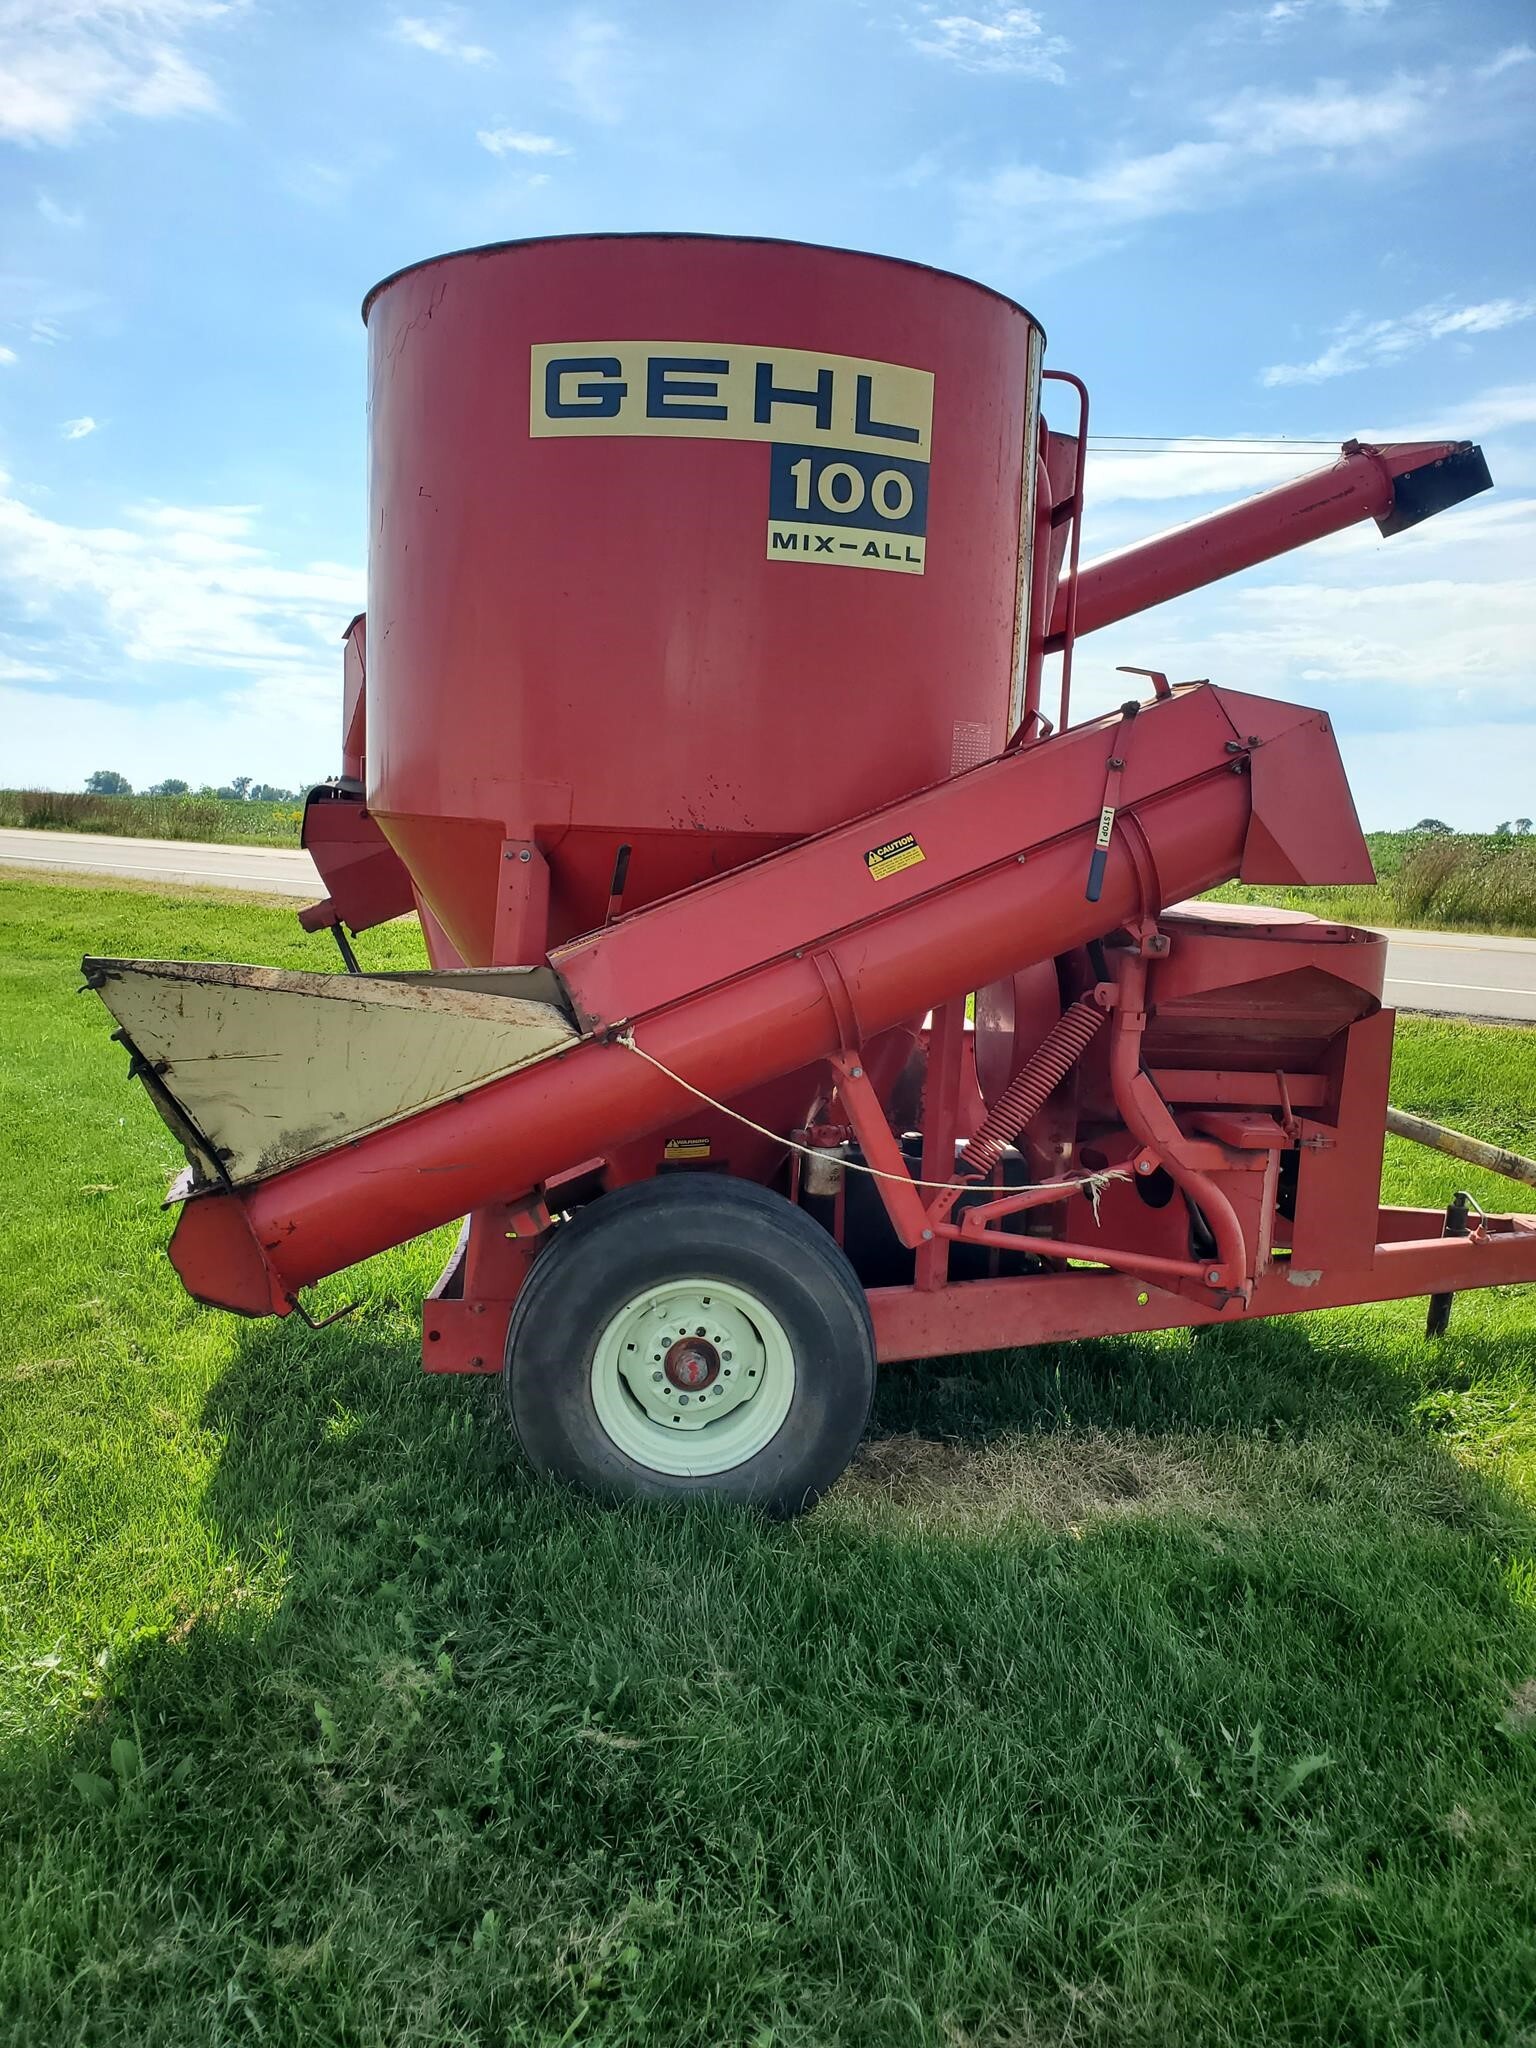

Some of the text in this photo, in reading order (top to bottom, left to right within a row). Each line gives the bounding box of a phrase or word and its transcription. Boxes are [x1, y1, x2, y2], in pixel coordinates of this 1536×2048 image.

[545, 357, 920, 443] GEHL
[790, 458, 914, 520] 100
[772, 532, 922, 564] MIX-ALL
[1101, 815, 1111, 837] STOP
[877, 834, 914, 856] CAUTION
